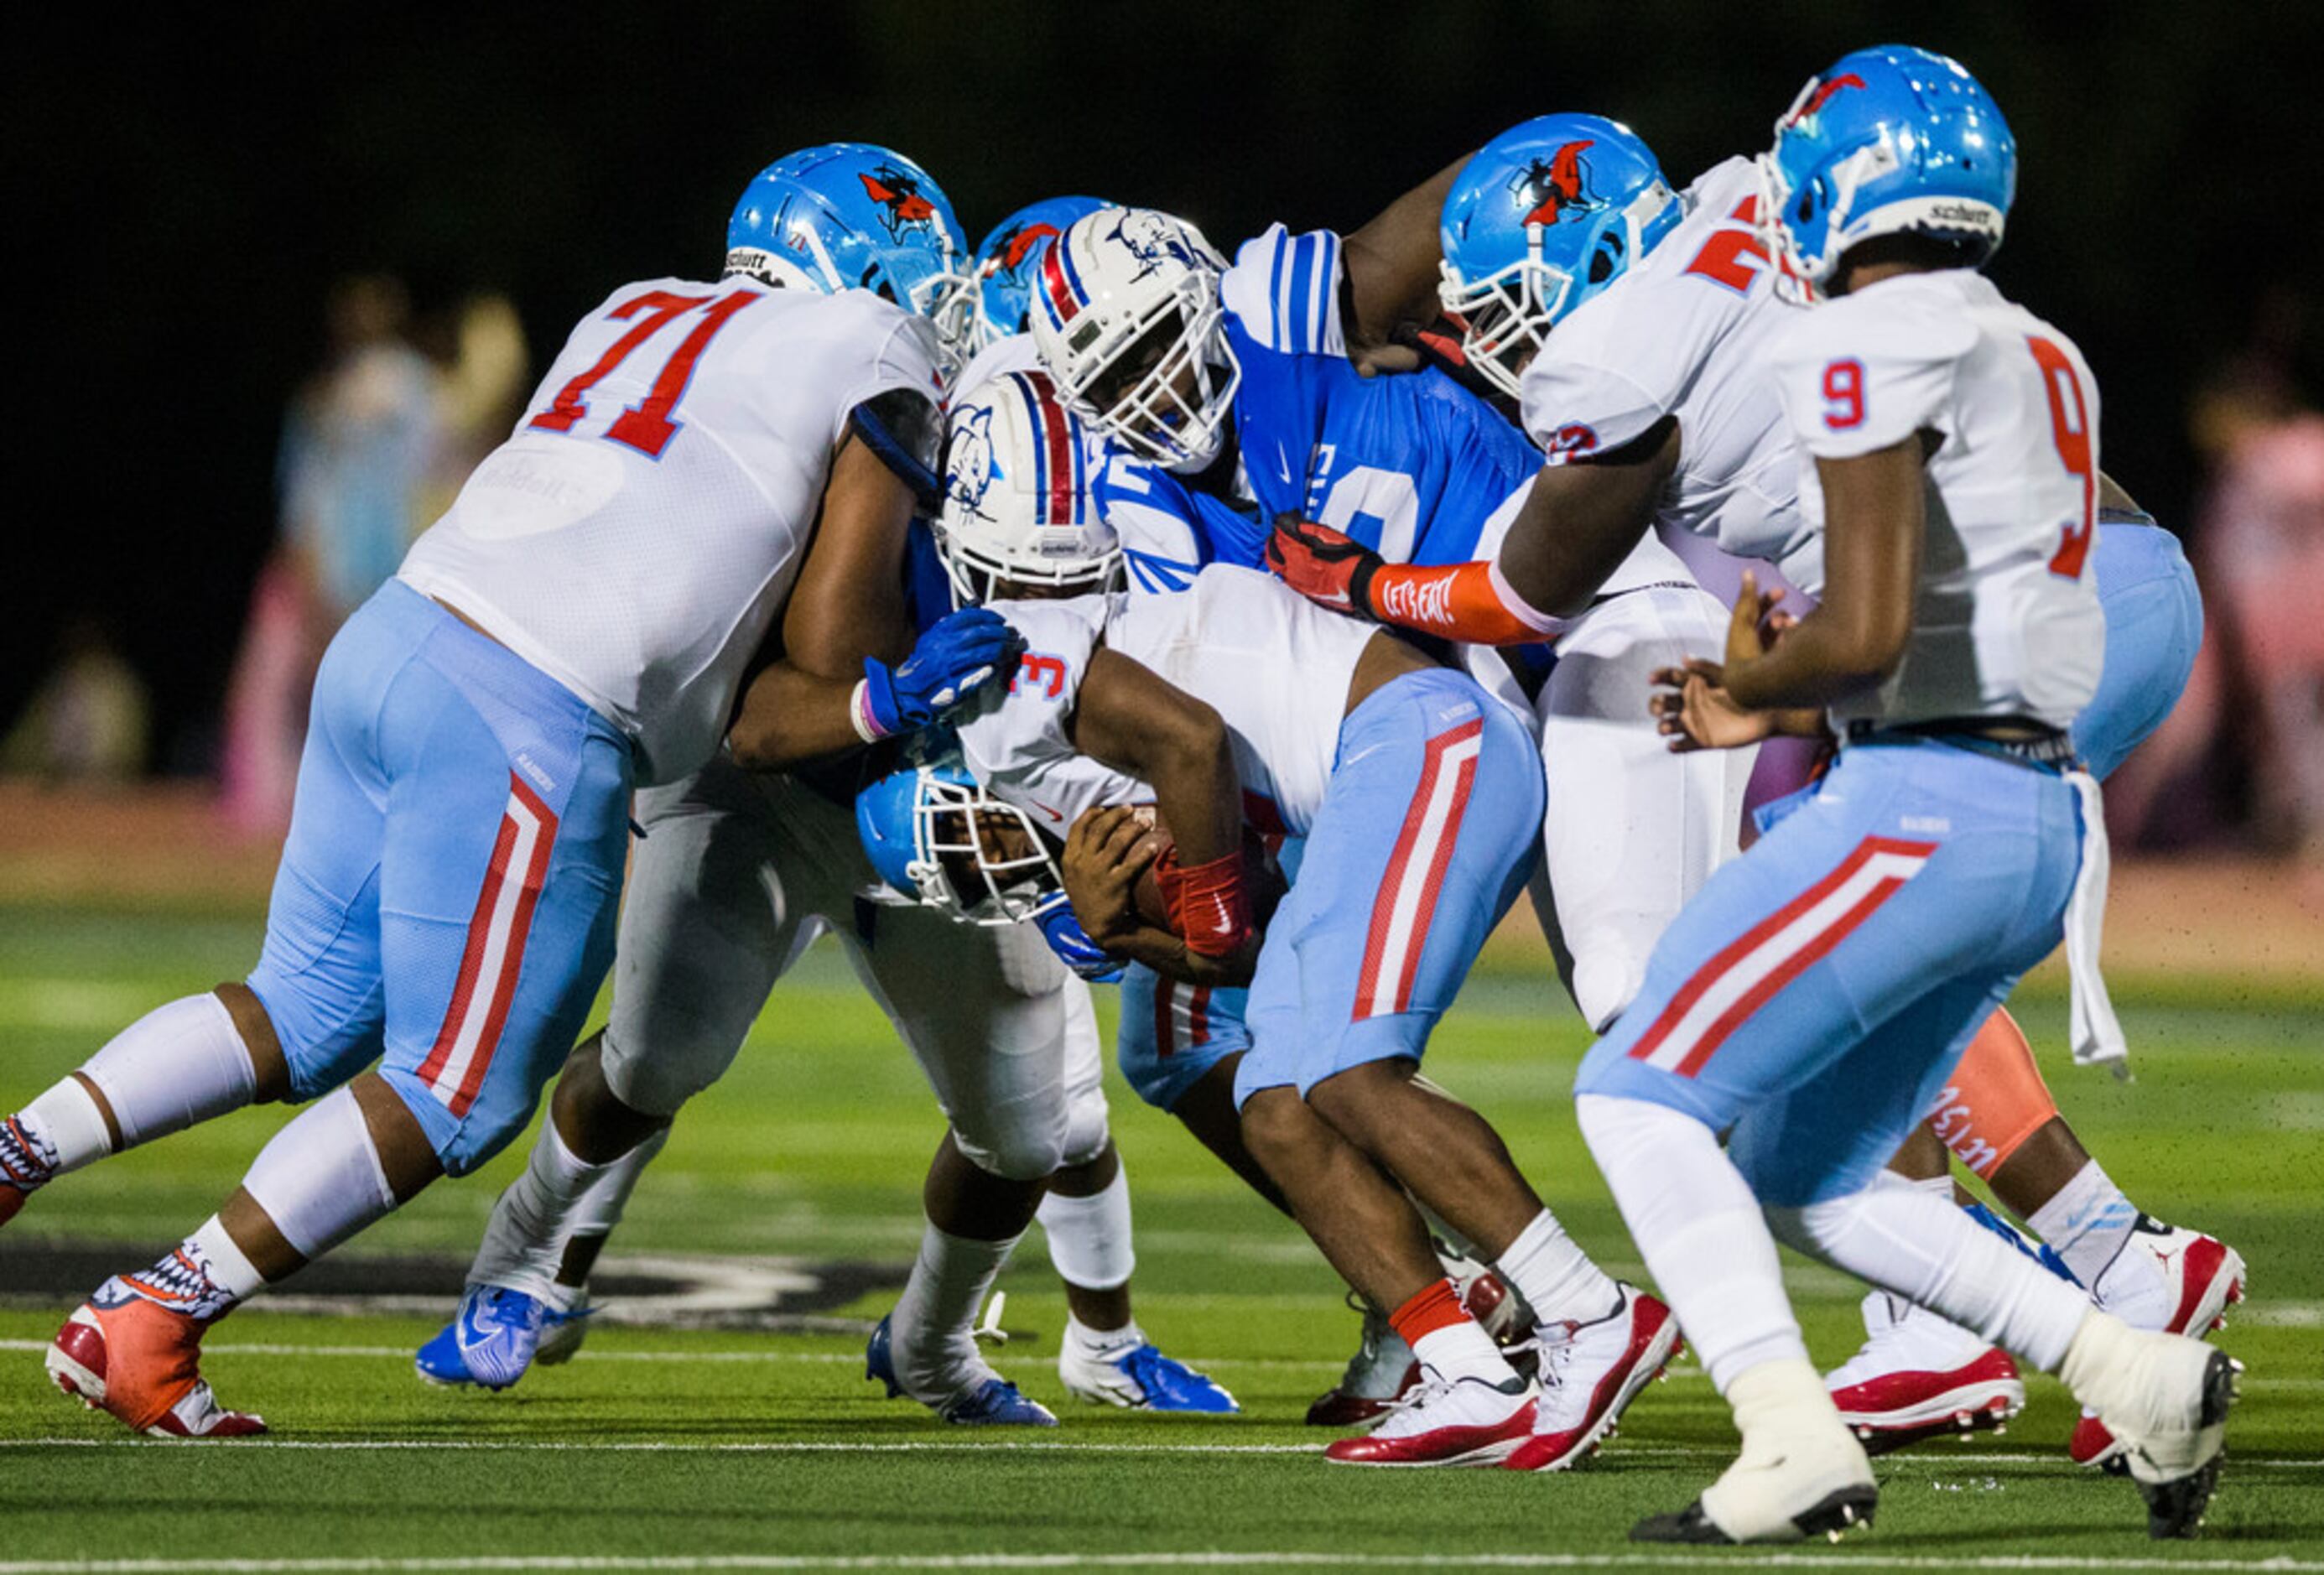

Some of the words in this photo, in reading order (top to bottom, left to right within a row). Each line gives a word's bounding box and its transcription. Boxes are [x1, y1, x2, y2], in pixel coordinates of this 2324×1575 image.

[528, 288, 764, 461] 71
[1821, 357, 1868, 433] 9
[2026, 335, 2095, 579] 9
